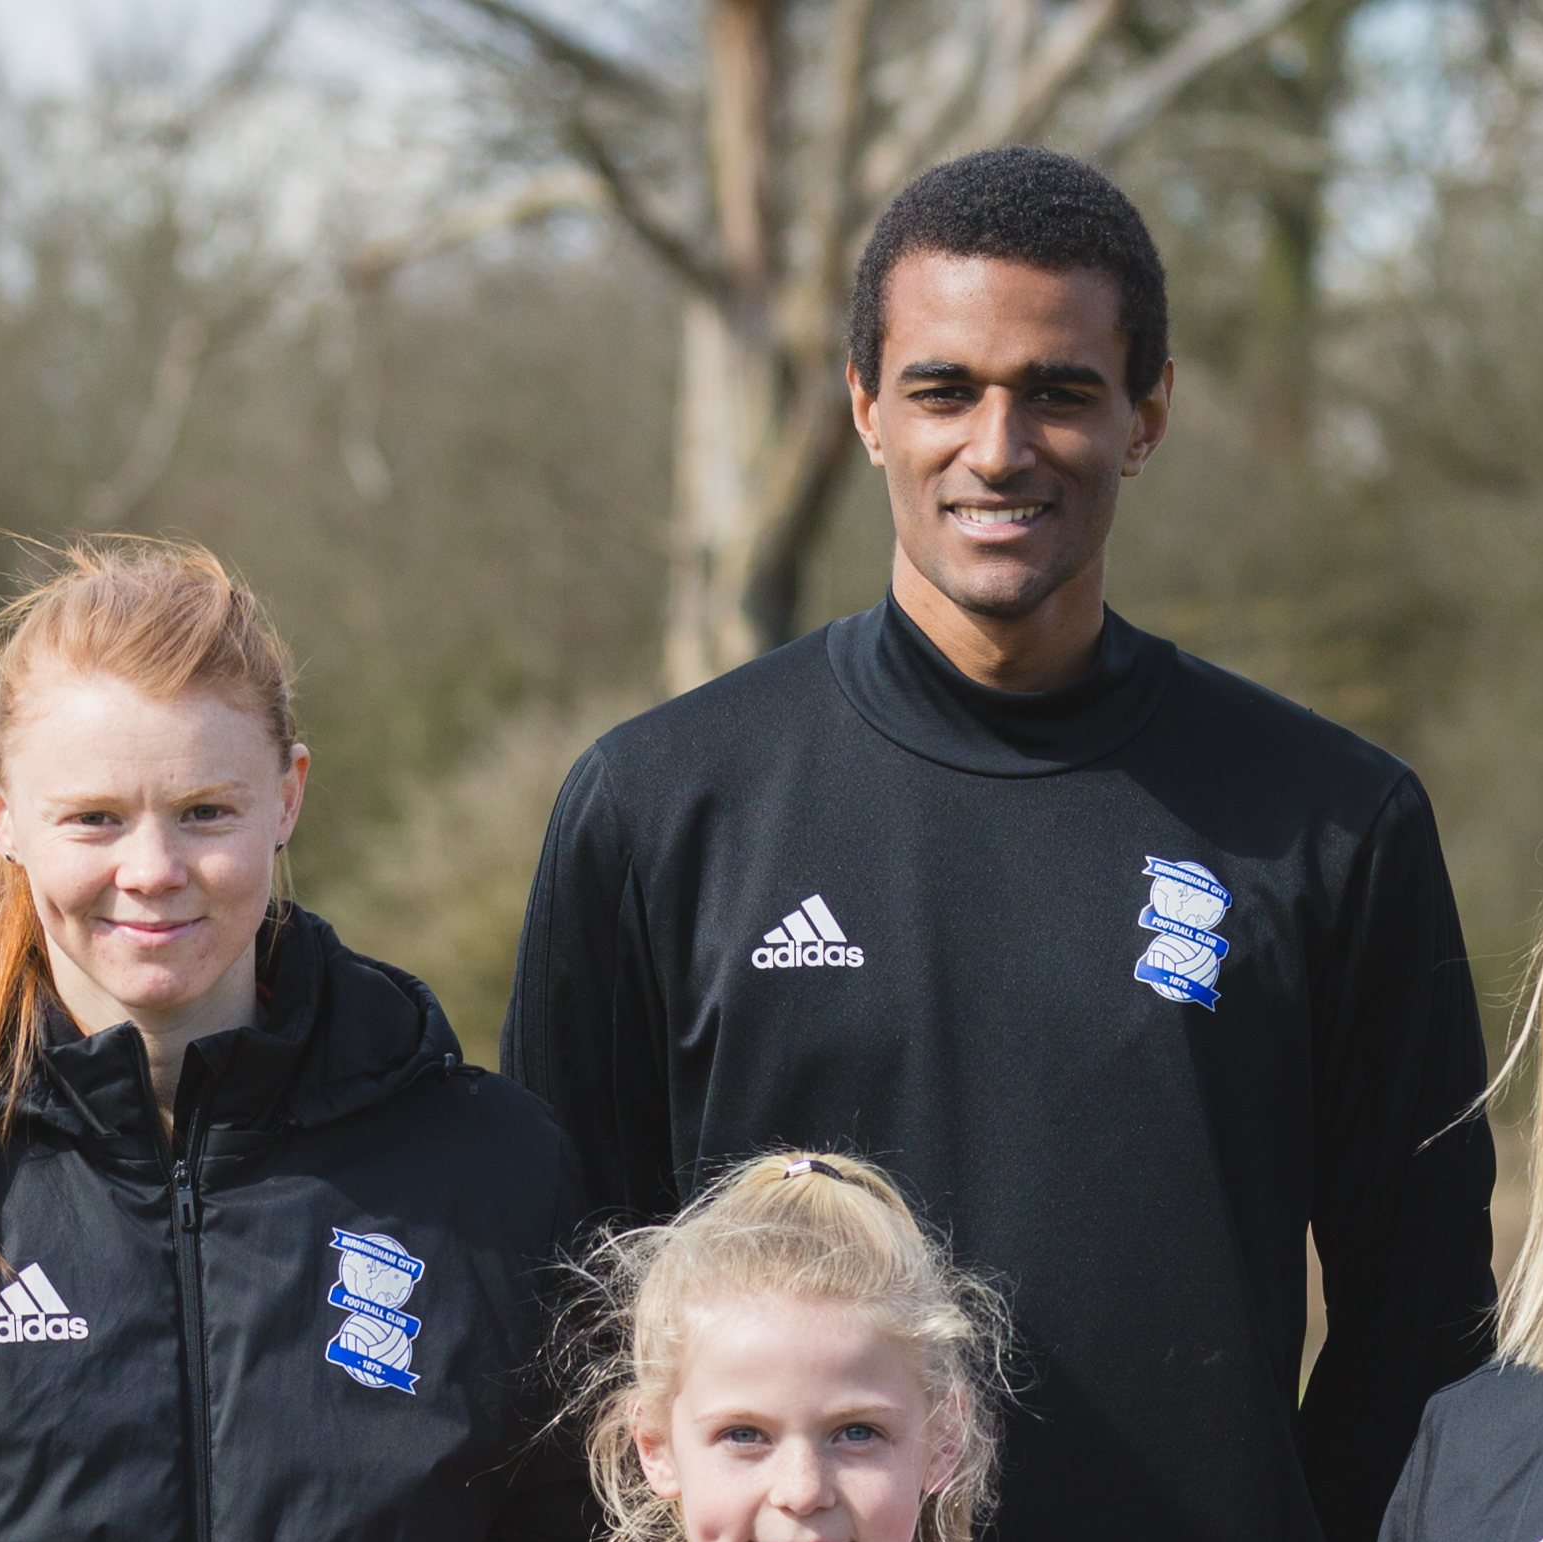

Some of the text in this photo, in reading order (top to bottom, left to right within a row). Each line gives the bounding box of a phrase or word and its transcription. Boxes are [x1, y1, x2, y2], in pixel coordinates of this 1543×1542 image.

[1153, 862, 1228, 900] BIRMINGHAM CITY
[1151, 916, 1217, 948] FOOTBALL CLUB
[751, 940, 865, 970] adidas
[340, 1236, 419, 1273] BIRMINGHAM CITY
[342, 1294, 407, 1328] FOOTBALL CLUB
